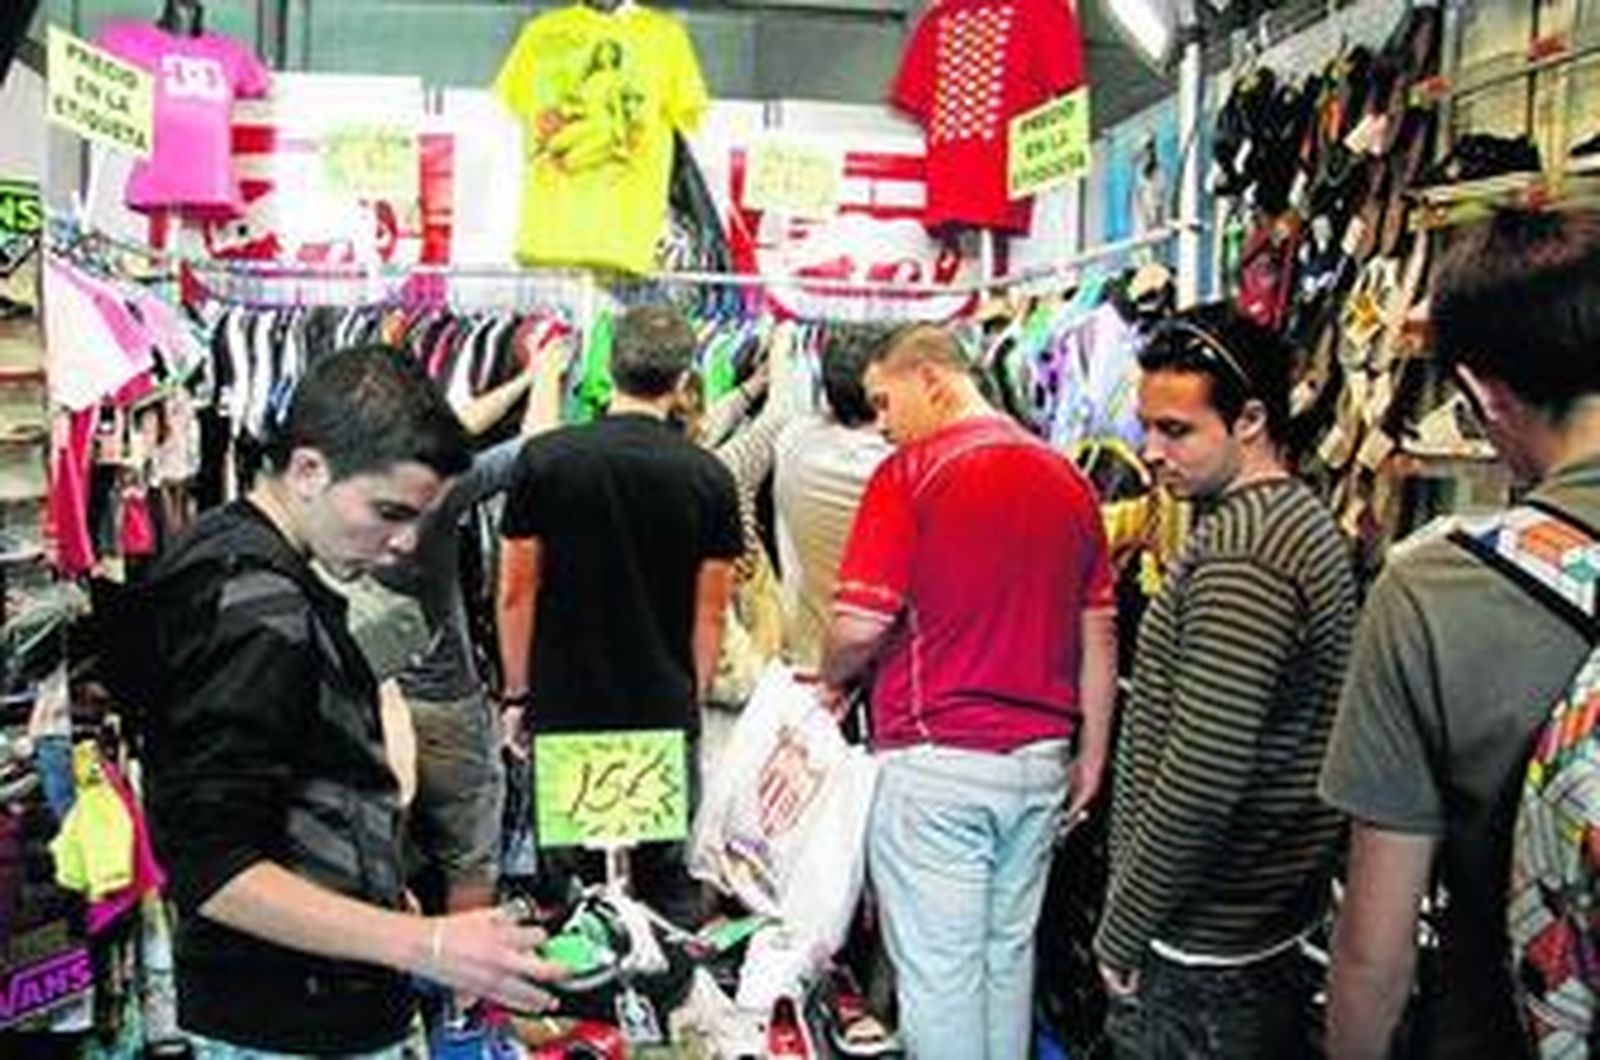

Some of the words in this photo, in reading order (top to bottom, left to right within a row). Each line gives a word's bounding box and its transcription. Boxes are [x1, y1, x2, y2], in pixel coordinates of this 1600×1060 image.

[65, 42, 139, 90] PRECIO
[75, 75, 101, 100] EN
[105, 91, 130, 115] LA
[54, 94, 149, 152] ETIQUETA
[1025, 141, 1046, 161] EN
